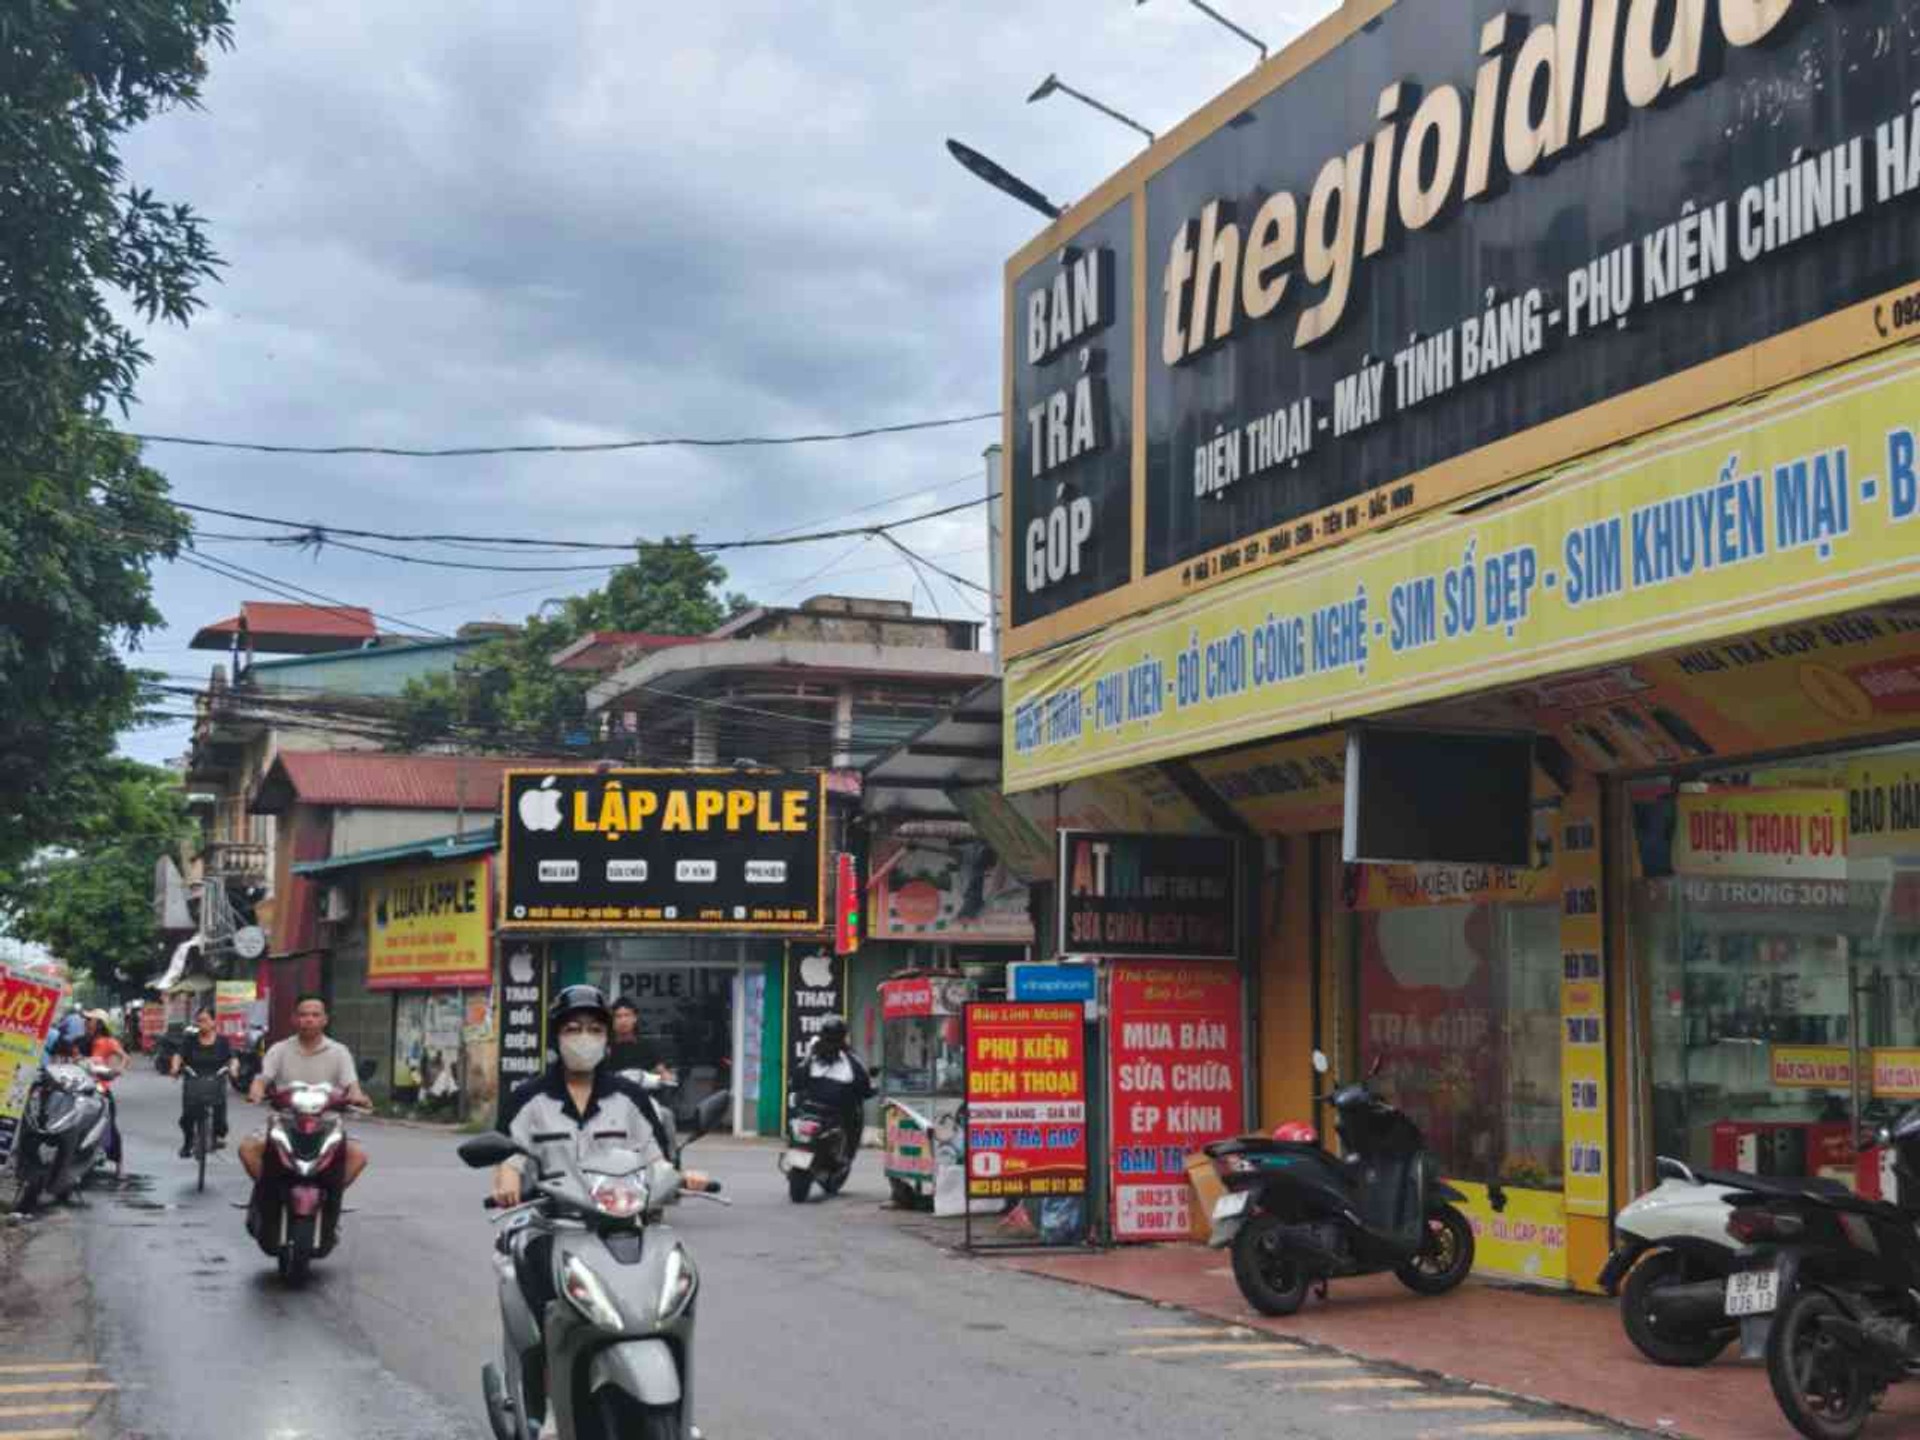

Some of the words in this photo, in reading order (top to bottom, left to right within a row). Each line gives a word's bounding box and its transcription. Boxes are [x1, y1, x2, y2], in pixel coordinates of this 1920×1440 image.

[1027, 248, 1099, 365] BÁN
[1194, 424, 1240, 500] ĐIỆN
[1246, 396, 1312, 469] THOẠI
[1334, 353, 1385, 438] MÁY
[1394, 332, 1454, 411] TÍNH
[1461, 286, 1542, 382] BẢNG
[1567, 243, 1633, 336] PHỤ
[1643, 199, 1728, 304] KIỆN
[1737, 146, 1863, 263] CHÍNH
[1028, 348, 1096, 478] TRẢ
[1026, 482, 1093, 593] GÓP
[1094, 670, 1123, 734] PHỤ
[1127, 654, 1164, 727] KIỆN
[1205, 632, 1249, 700] CHƠI
[1252, 612, 1305, 685] CÔNG
[1311, 585, 1368, 675] NGHỆ
[1389, 576, 1436, 651] SIM
[1443, 538, 1477, 637] SỐ
[1484, 546, 1537, 637] ĐẸP
[1565, 517, 1622, 604] SIM
[1631, 455, 1765, 588] KHUYẾN
[1774, 448, 1850, 557] MẠI
[572, 779, 658, 841] LẬP
[661, 789, 810, 832] APPLE
[1720, 881, 1798, 906] TRONG
[796, 990, 836, 1007] THAY
[977, 1037, 1018, 1064] PHỤ
[1024, 1032, 1069, 1064] KIỆN
[1123, 1023, 1174, 1049] MUA
[1180, 1017, 1227, 1050] BÁN
[969, 1067, 1016, 1098] ĐIỆN
[1023, 1070, 1078, 1098] THOẠI
[1119, 1056, 1165, 1092] SỬA
[1171, 1058, 1233, 1092] CHỮA
[1130, 1100, 1160, 1133] ÉP
[1167, 1101, 1223, 1133] KÍNH
[1161, 1146, 1191, 1174] TR
